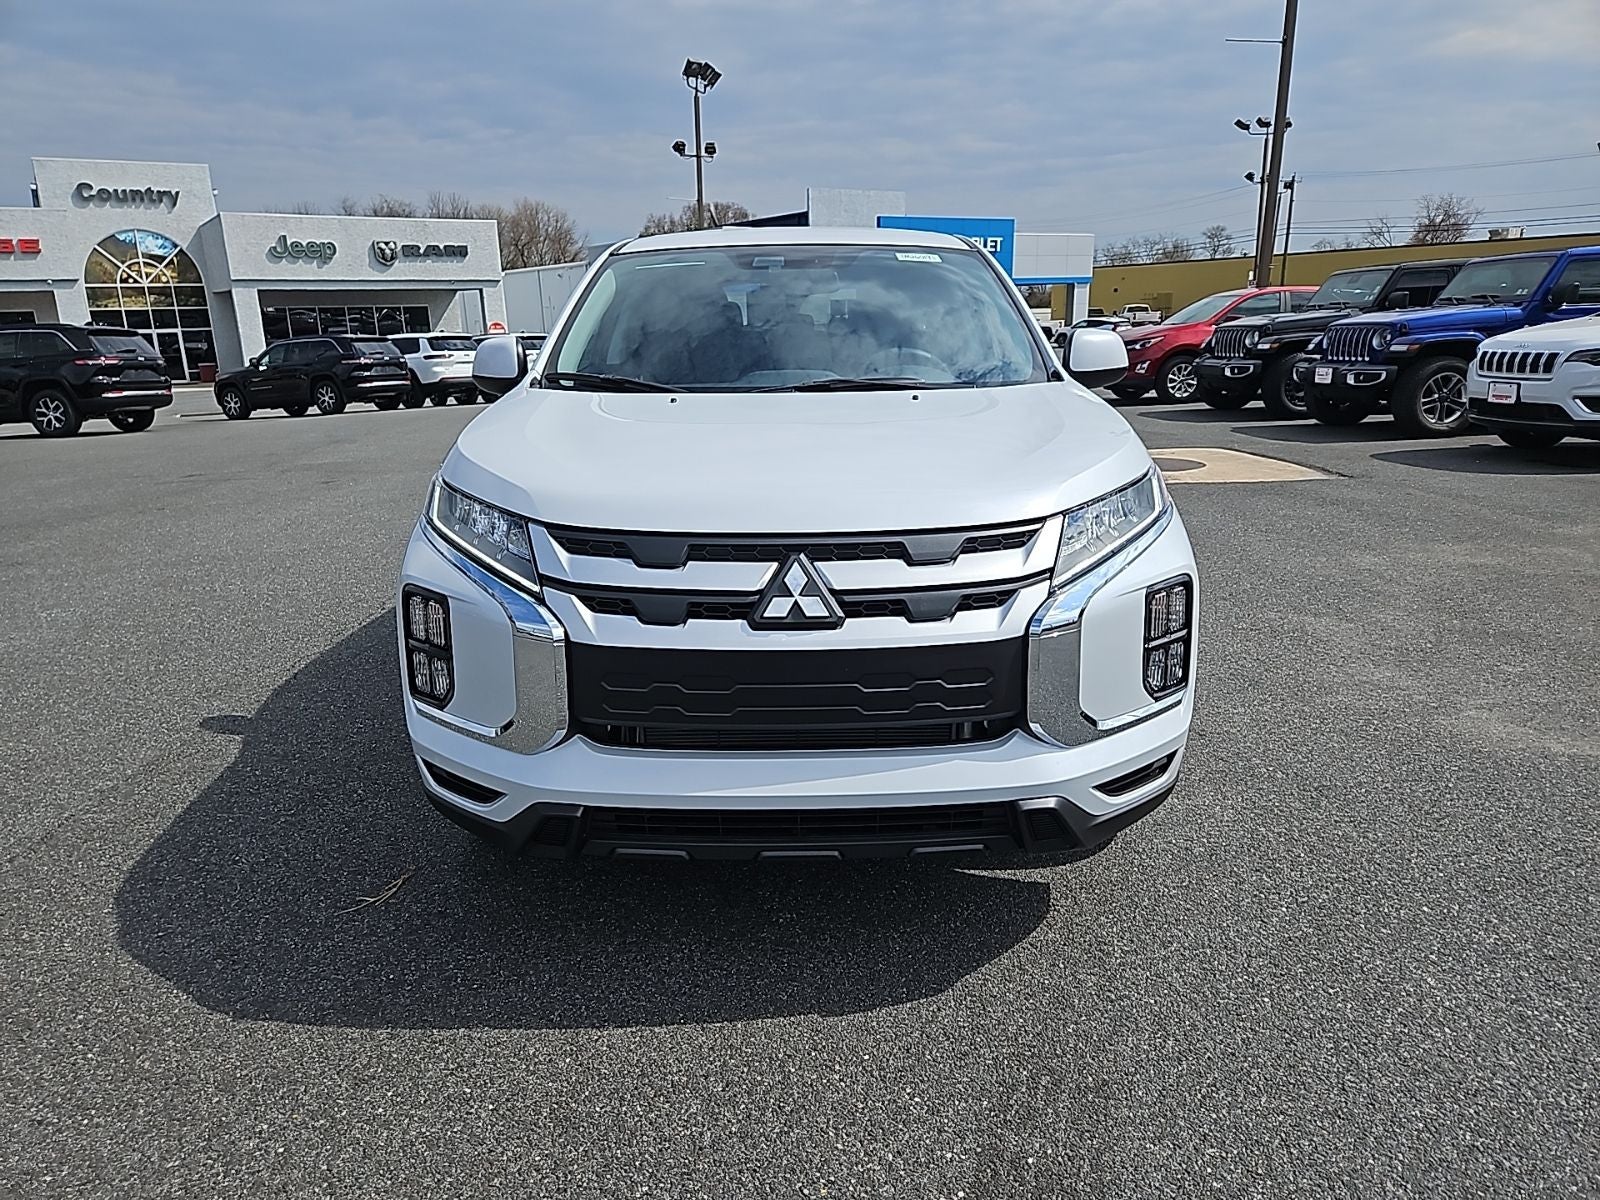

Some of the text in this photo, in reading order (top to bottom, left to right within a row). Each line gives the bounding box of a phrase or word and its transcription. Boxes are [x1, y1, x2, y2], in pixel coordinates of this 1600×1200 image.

[74, 182, 181, 211] Country
[269, 234, 337, 263] Jeep
[402, 244, 469, 258] RAM
